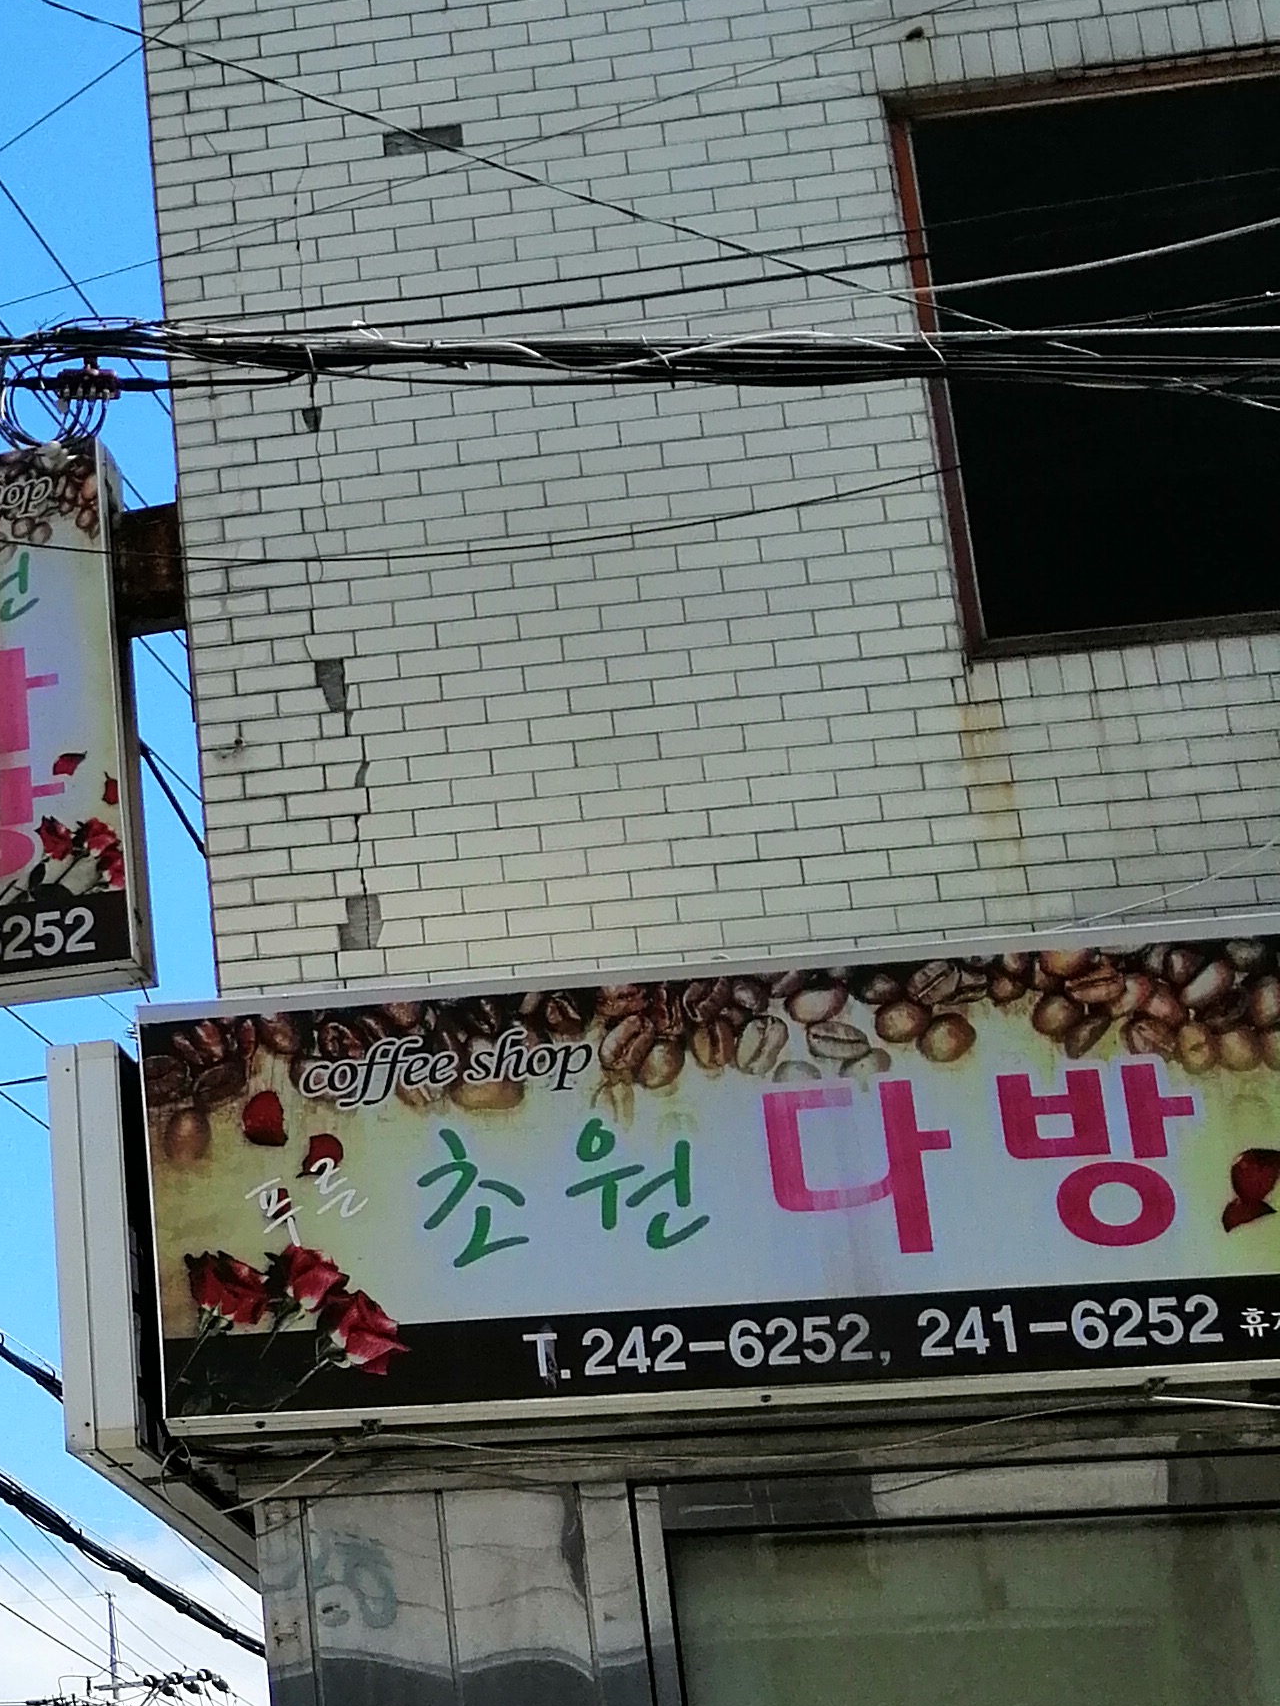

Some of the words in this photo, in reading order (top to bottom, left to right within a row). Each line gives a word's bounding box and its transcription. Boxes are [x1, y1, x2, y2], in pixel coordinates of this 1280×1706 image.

[301, 1033, 457, 1107] coffee
[469, 1025, 592, 1093] shop
[416, 1117, 711, 1269] 초원
[761, 1062, 1196, 1255] 다방
[917, 1294, 1224, 1358] 241-6252
